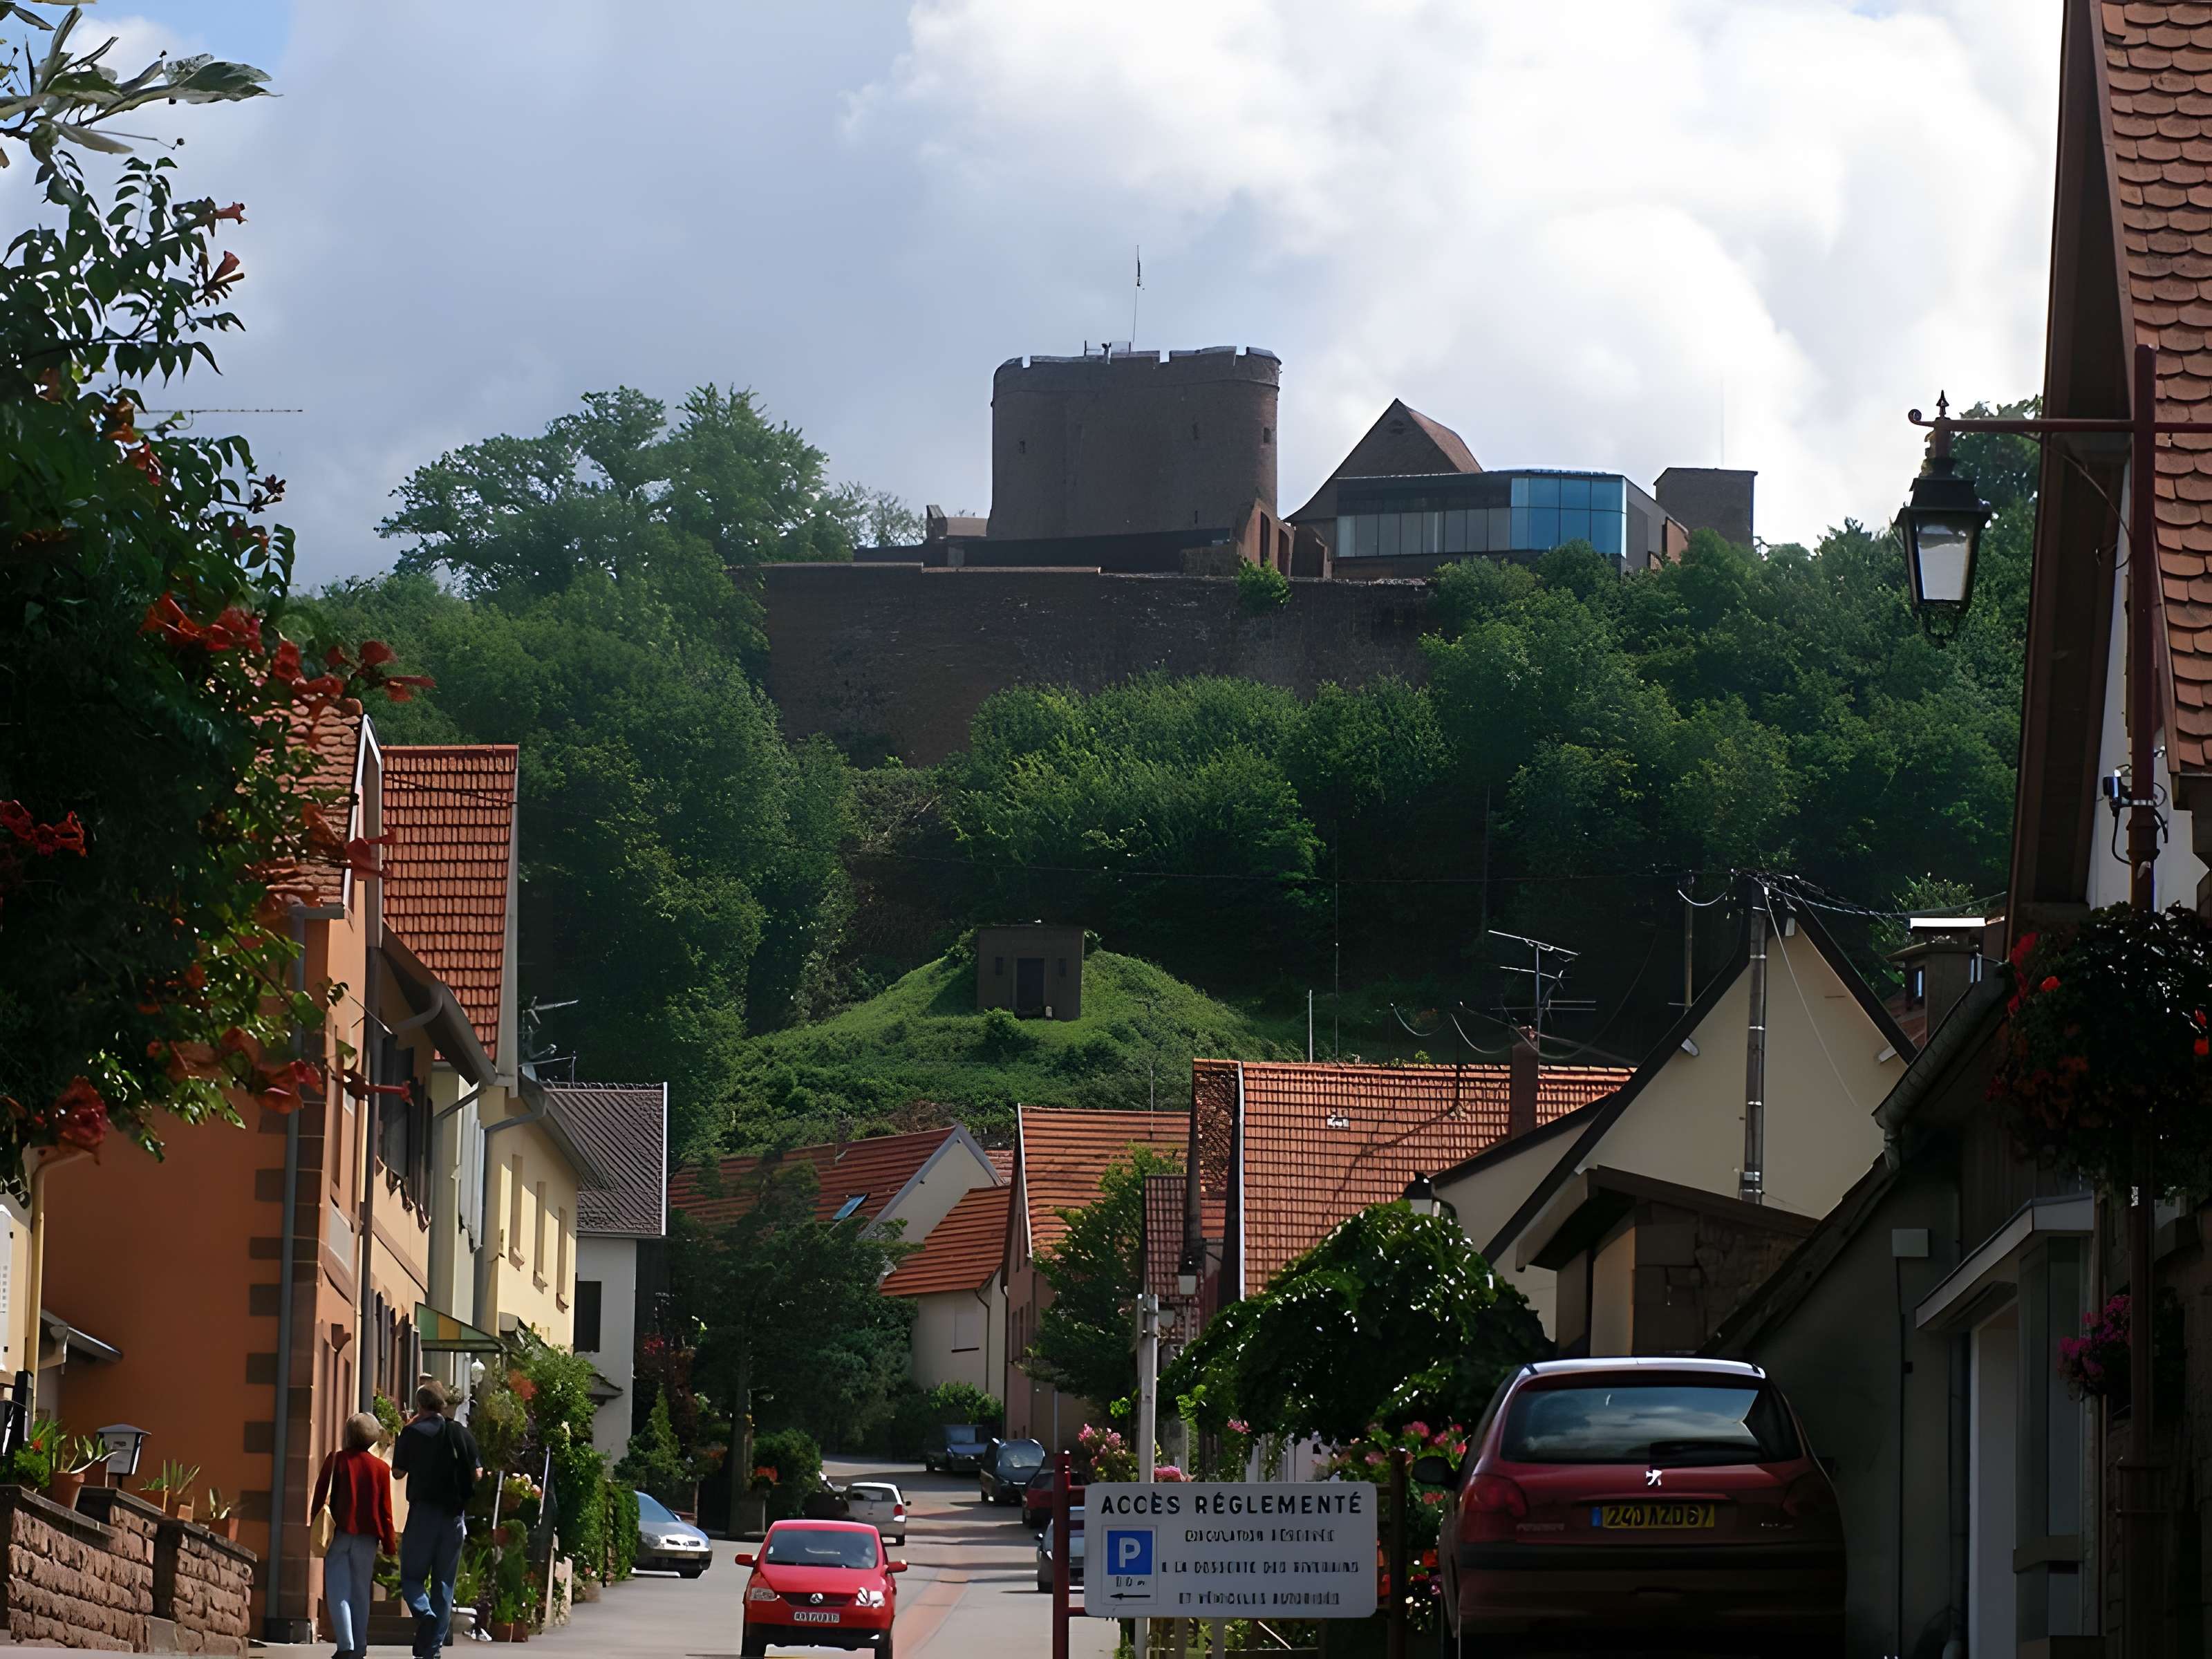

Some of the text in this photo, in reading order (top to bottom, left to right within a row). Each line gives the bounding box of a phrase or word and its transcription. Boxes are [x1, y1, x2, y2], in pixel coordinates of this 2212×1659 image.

[1101, 1492, 1362, 1515] ACCÈS RÉGLEMENTÉ
[1118, 1537, 1141, 1568] P
